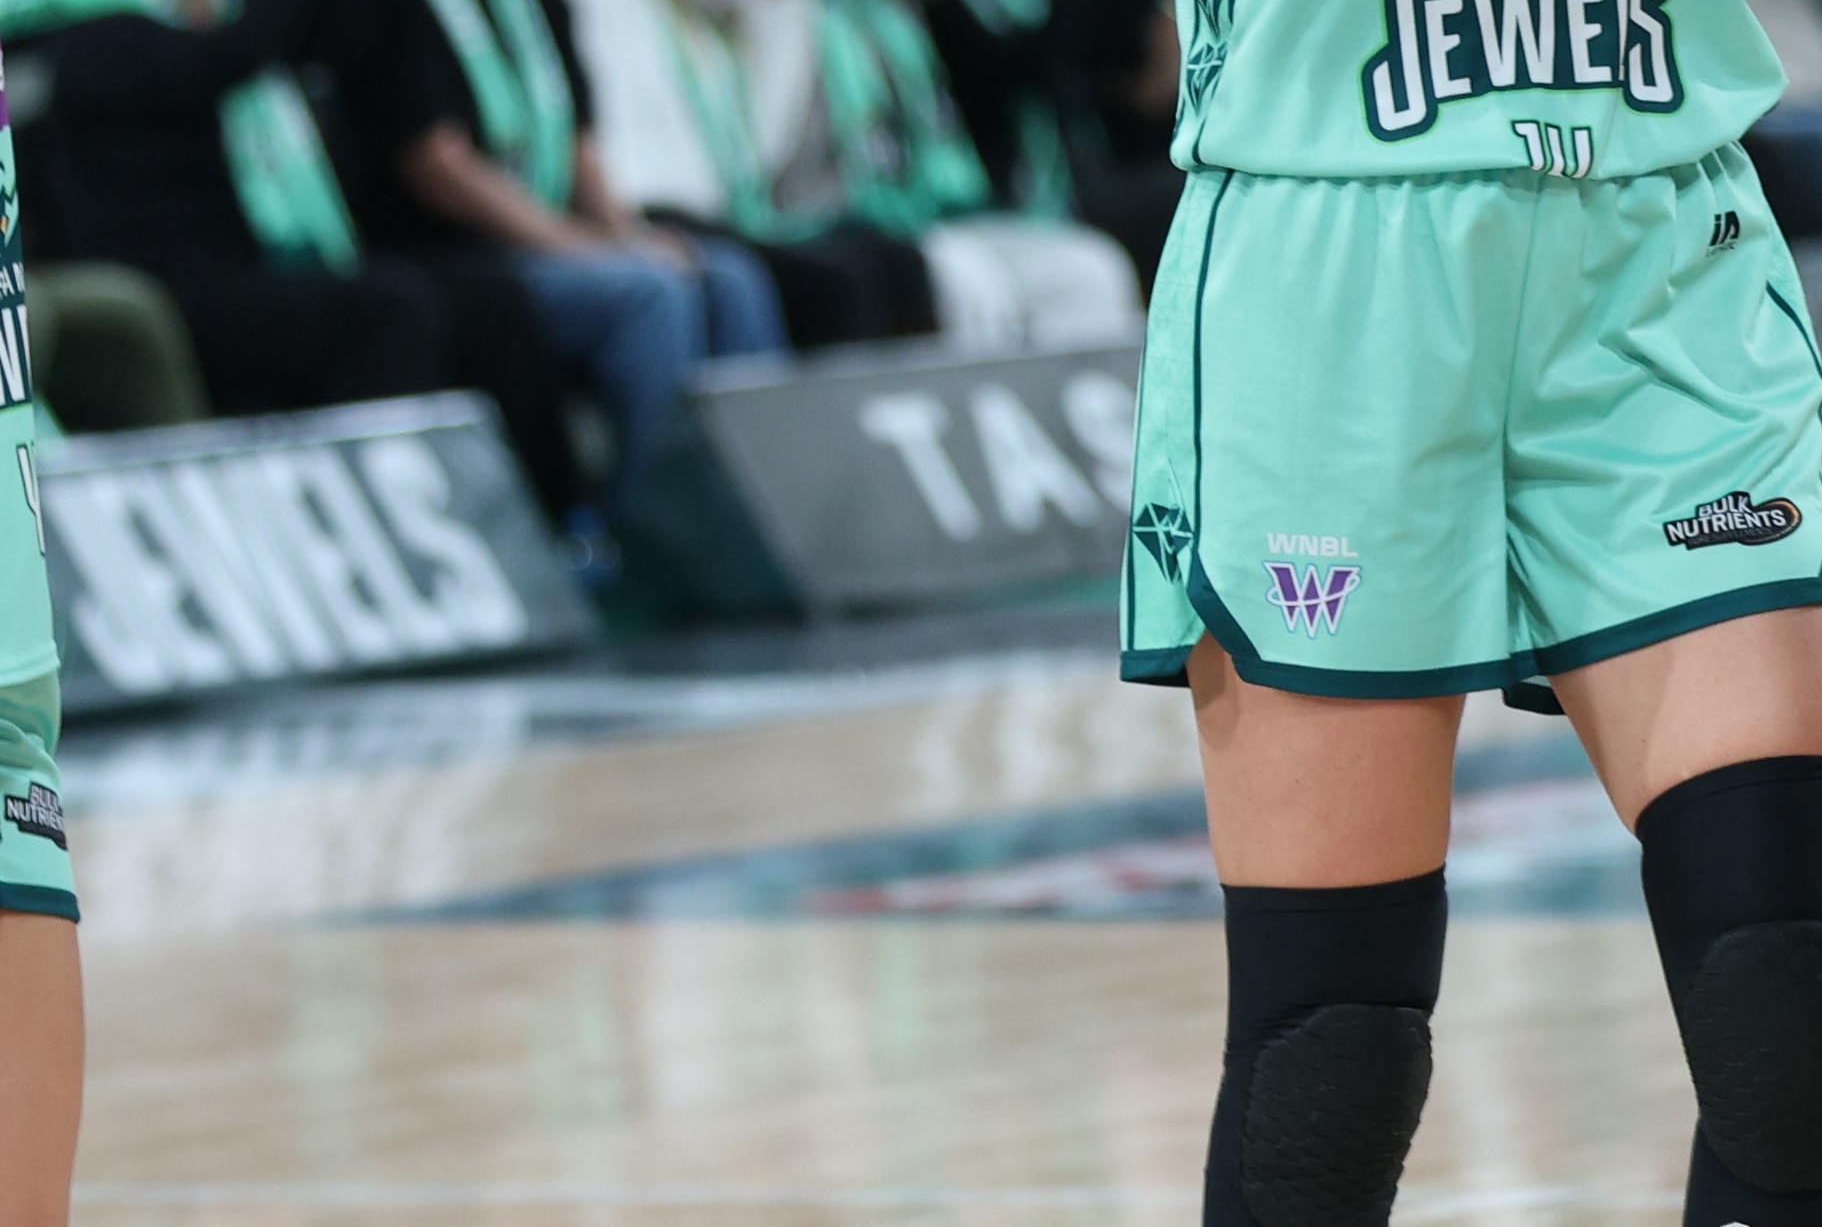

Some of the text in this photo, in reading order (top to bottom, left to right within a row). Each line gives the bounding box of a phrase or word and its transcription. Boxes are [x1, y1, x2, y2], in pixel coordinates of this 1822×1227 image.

[1698, 494, 1752, 518] BULK
[1666, 508, 1787, 543] NUTRIENTS
[1266, 533, 1359, 558] WNBL
[50, 435, 530, 695] JEWELS
